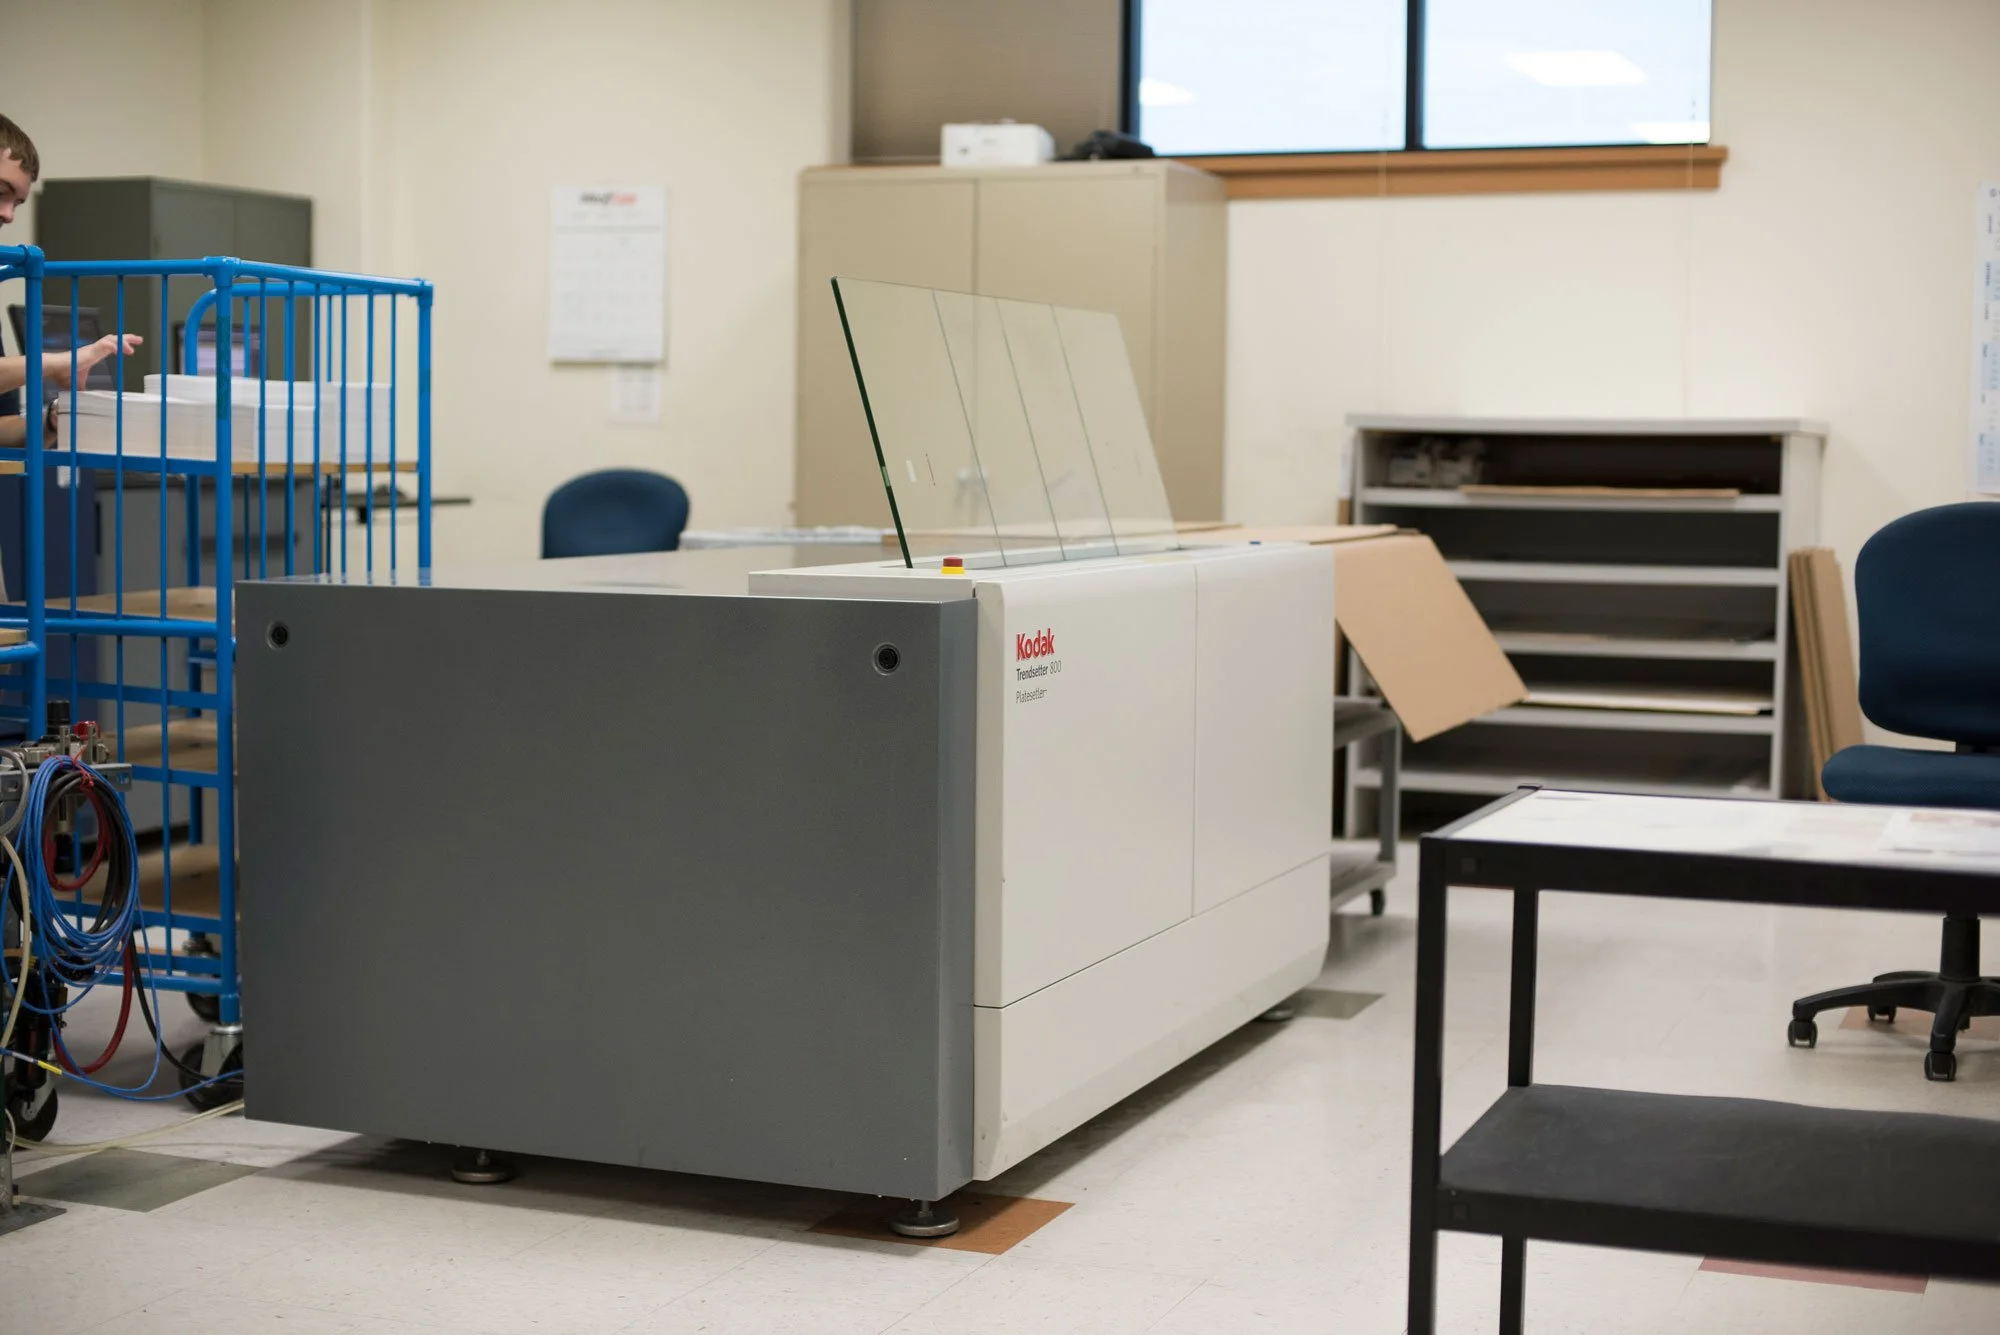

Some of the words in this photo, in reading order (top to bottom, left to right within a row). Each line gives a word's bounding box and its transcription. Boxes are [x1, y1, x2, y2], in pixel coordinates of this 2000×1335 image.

[1016, 628, 1055, 660] Kodak
[1016, 665, 1048, 681] Trendsetter
[1049, 660, 1062, 674] 800
